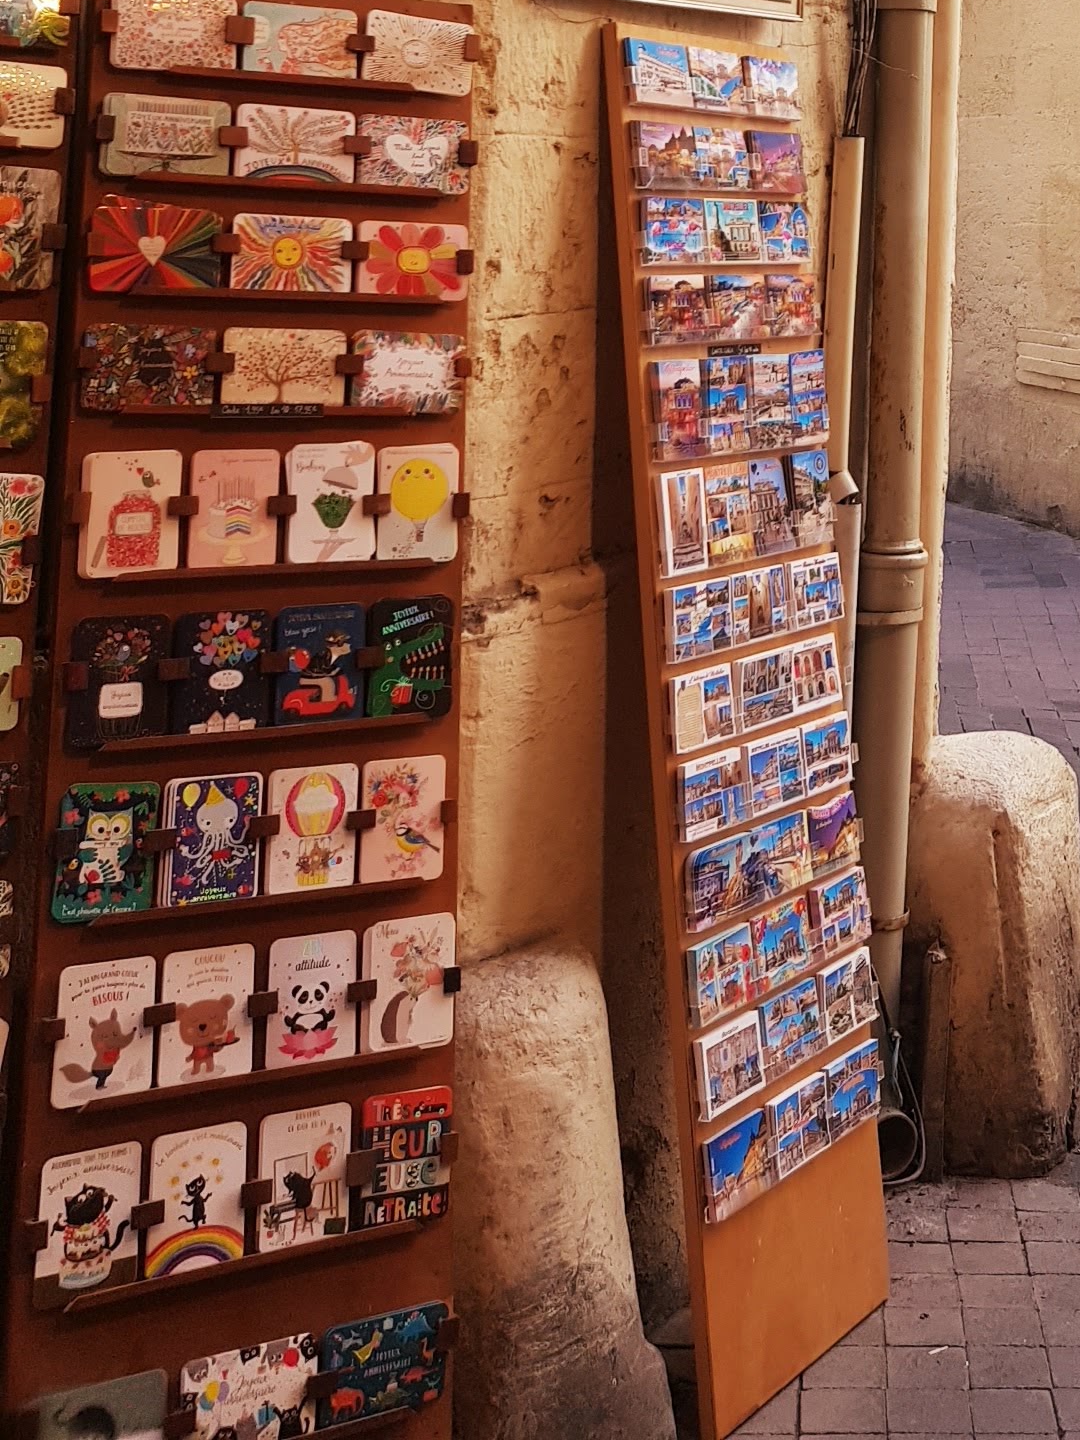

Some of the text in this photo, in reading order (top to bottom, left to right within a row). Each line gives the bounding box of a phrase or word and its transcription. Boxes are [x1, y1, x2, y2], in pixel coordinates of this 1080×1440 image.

[393, 605, 419, 622] JOYEUX
[295, 955, 331, 972] attitude
[92, 991, 123, 1007] BISOUS
